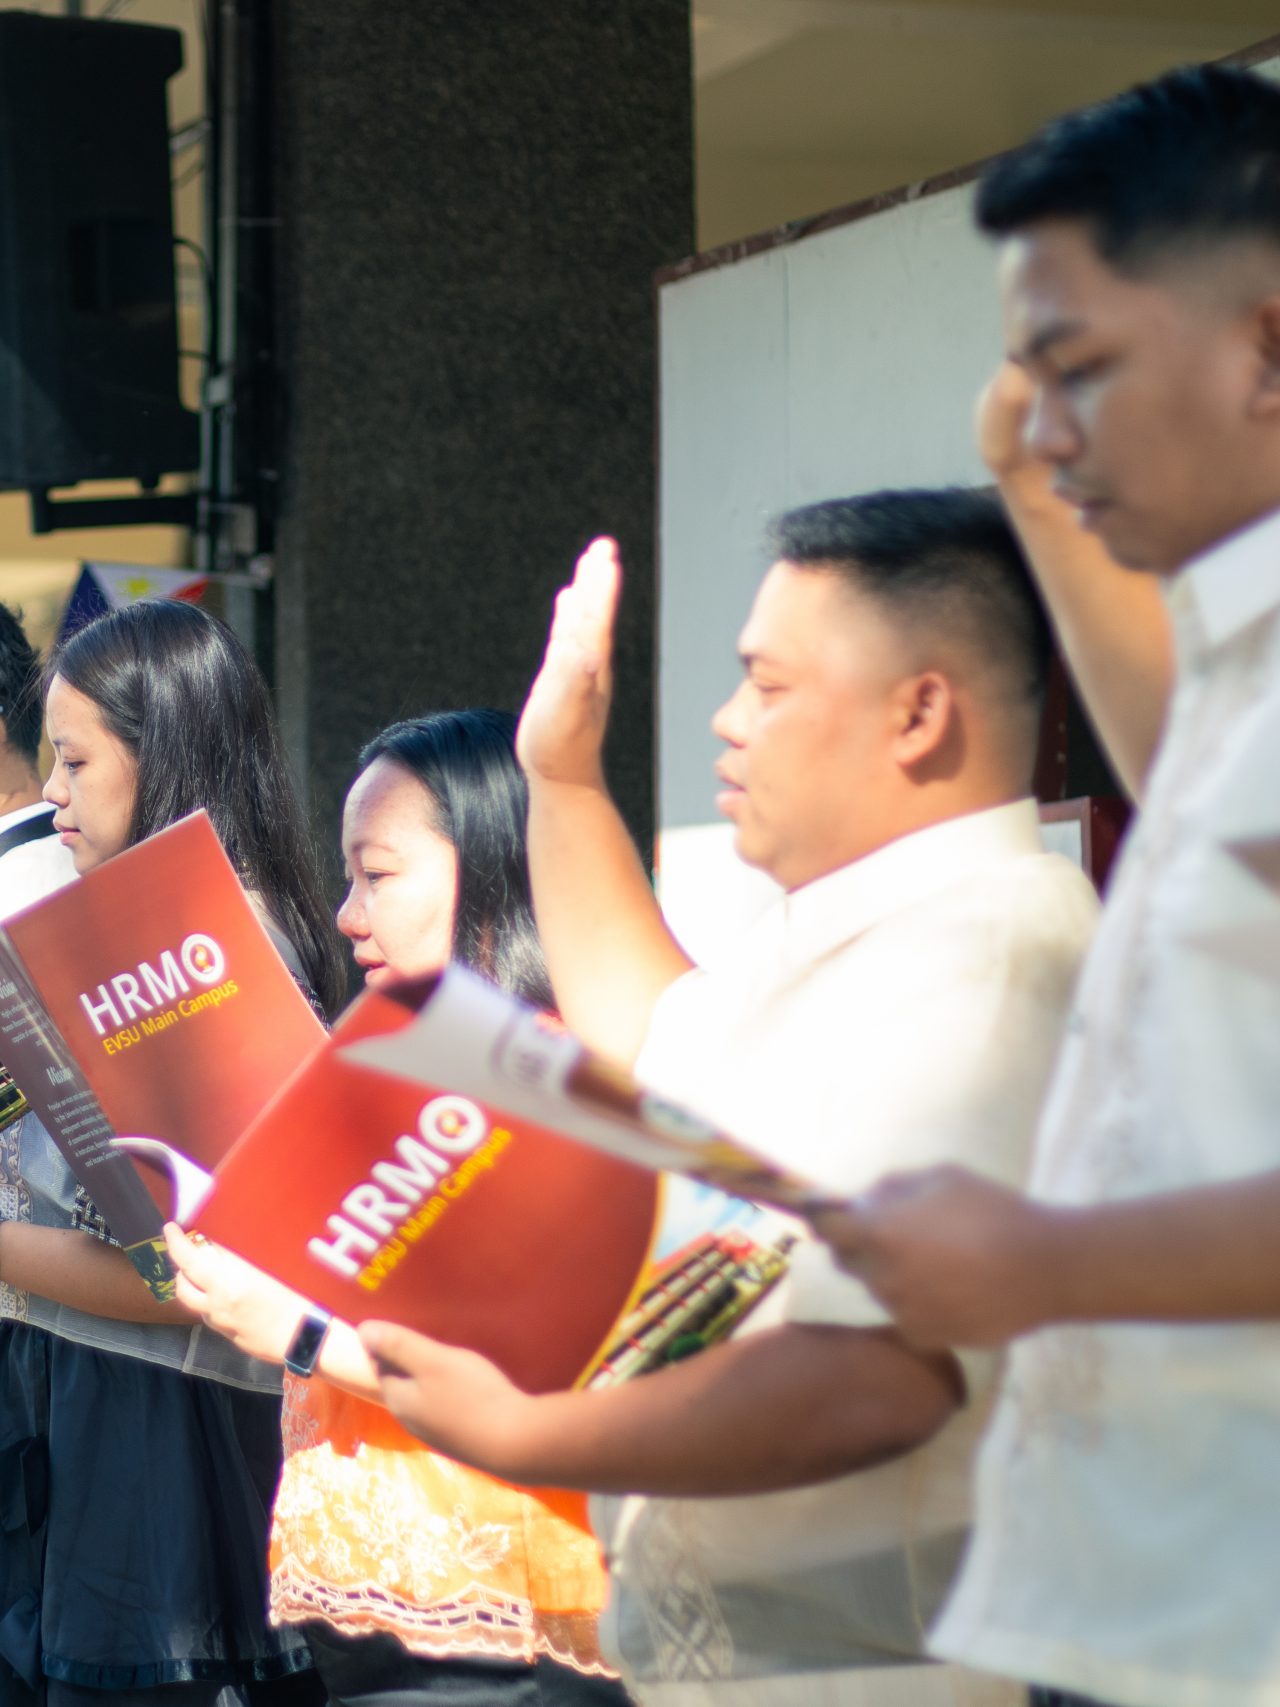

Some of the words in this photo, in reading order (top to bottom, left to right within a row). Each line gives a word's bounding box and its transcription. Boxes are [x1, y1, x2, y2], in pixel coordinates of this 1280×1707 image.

[102, 1026, 141, 1055] EVSU
[140, 1010, 179, 1037] Main
[178, 979, 238, 1017] Campus
[356, 1237, 407, 1291] EVSU
[398, 1195, 448, 1242] Main
[439, 1127, 512, 1198] Campus
